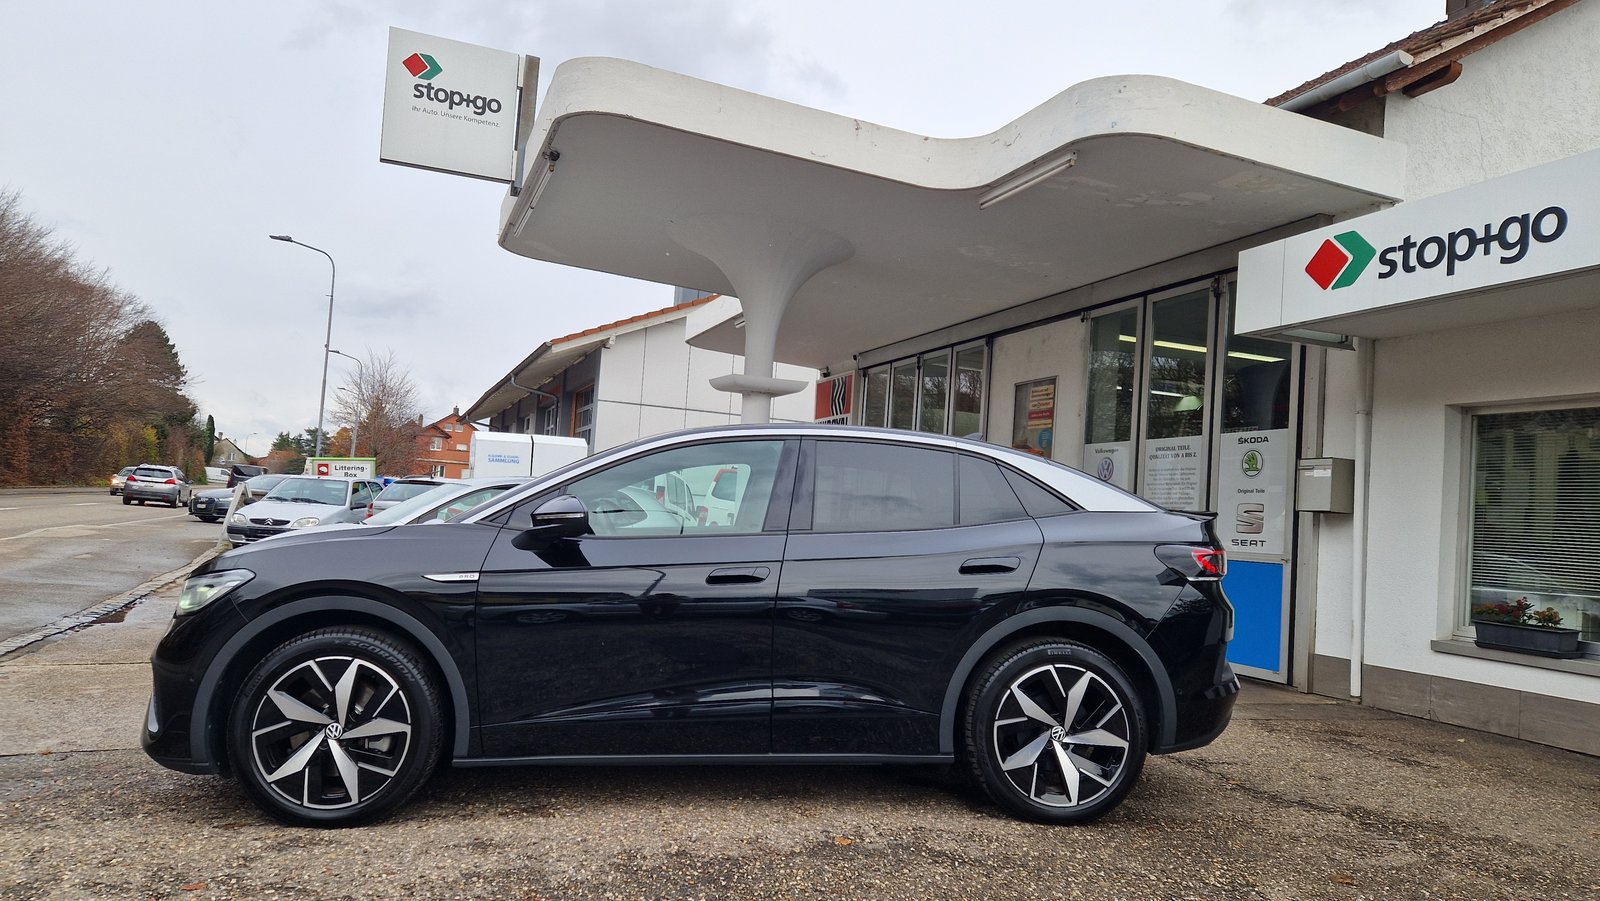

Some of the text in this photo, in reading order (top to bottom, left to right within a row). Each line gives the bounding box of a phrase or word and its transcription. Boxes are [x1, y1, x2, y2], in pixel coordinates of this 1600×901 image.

[413, 83, 502, 115] stop+go
[422, 107, 439, 116] Auto.
[440, 111, 462, 120] Unsere
[463, 115, 500, 127] Kompetenz.
[1378, 206, 1568, 279] stop+go
[1231, 539, 1267, 547] SEAT
[348, 640, 416, 682] SCORPION
